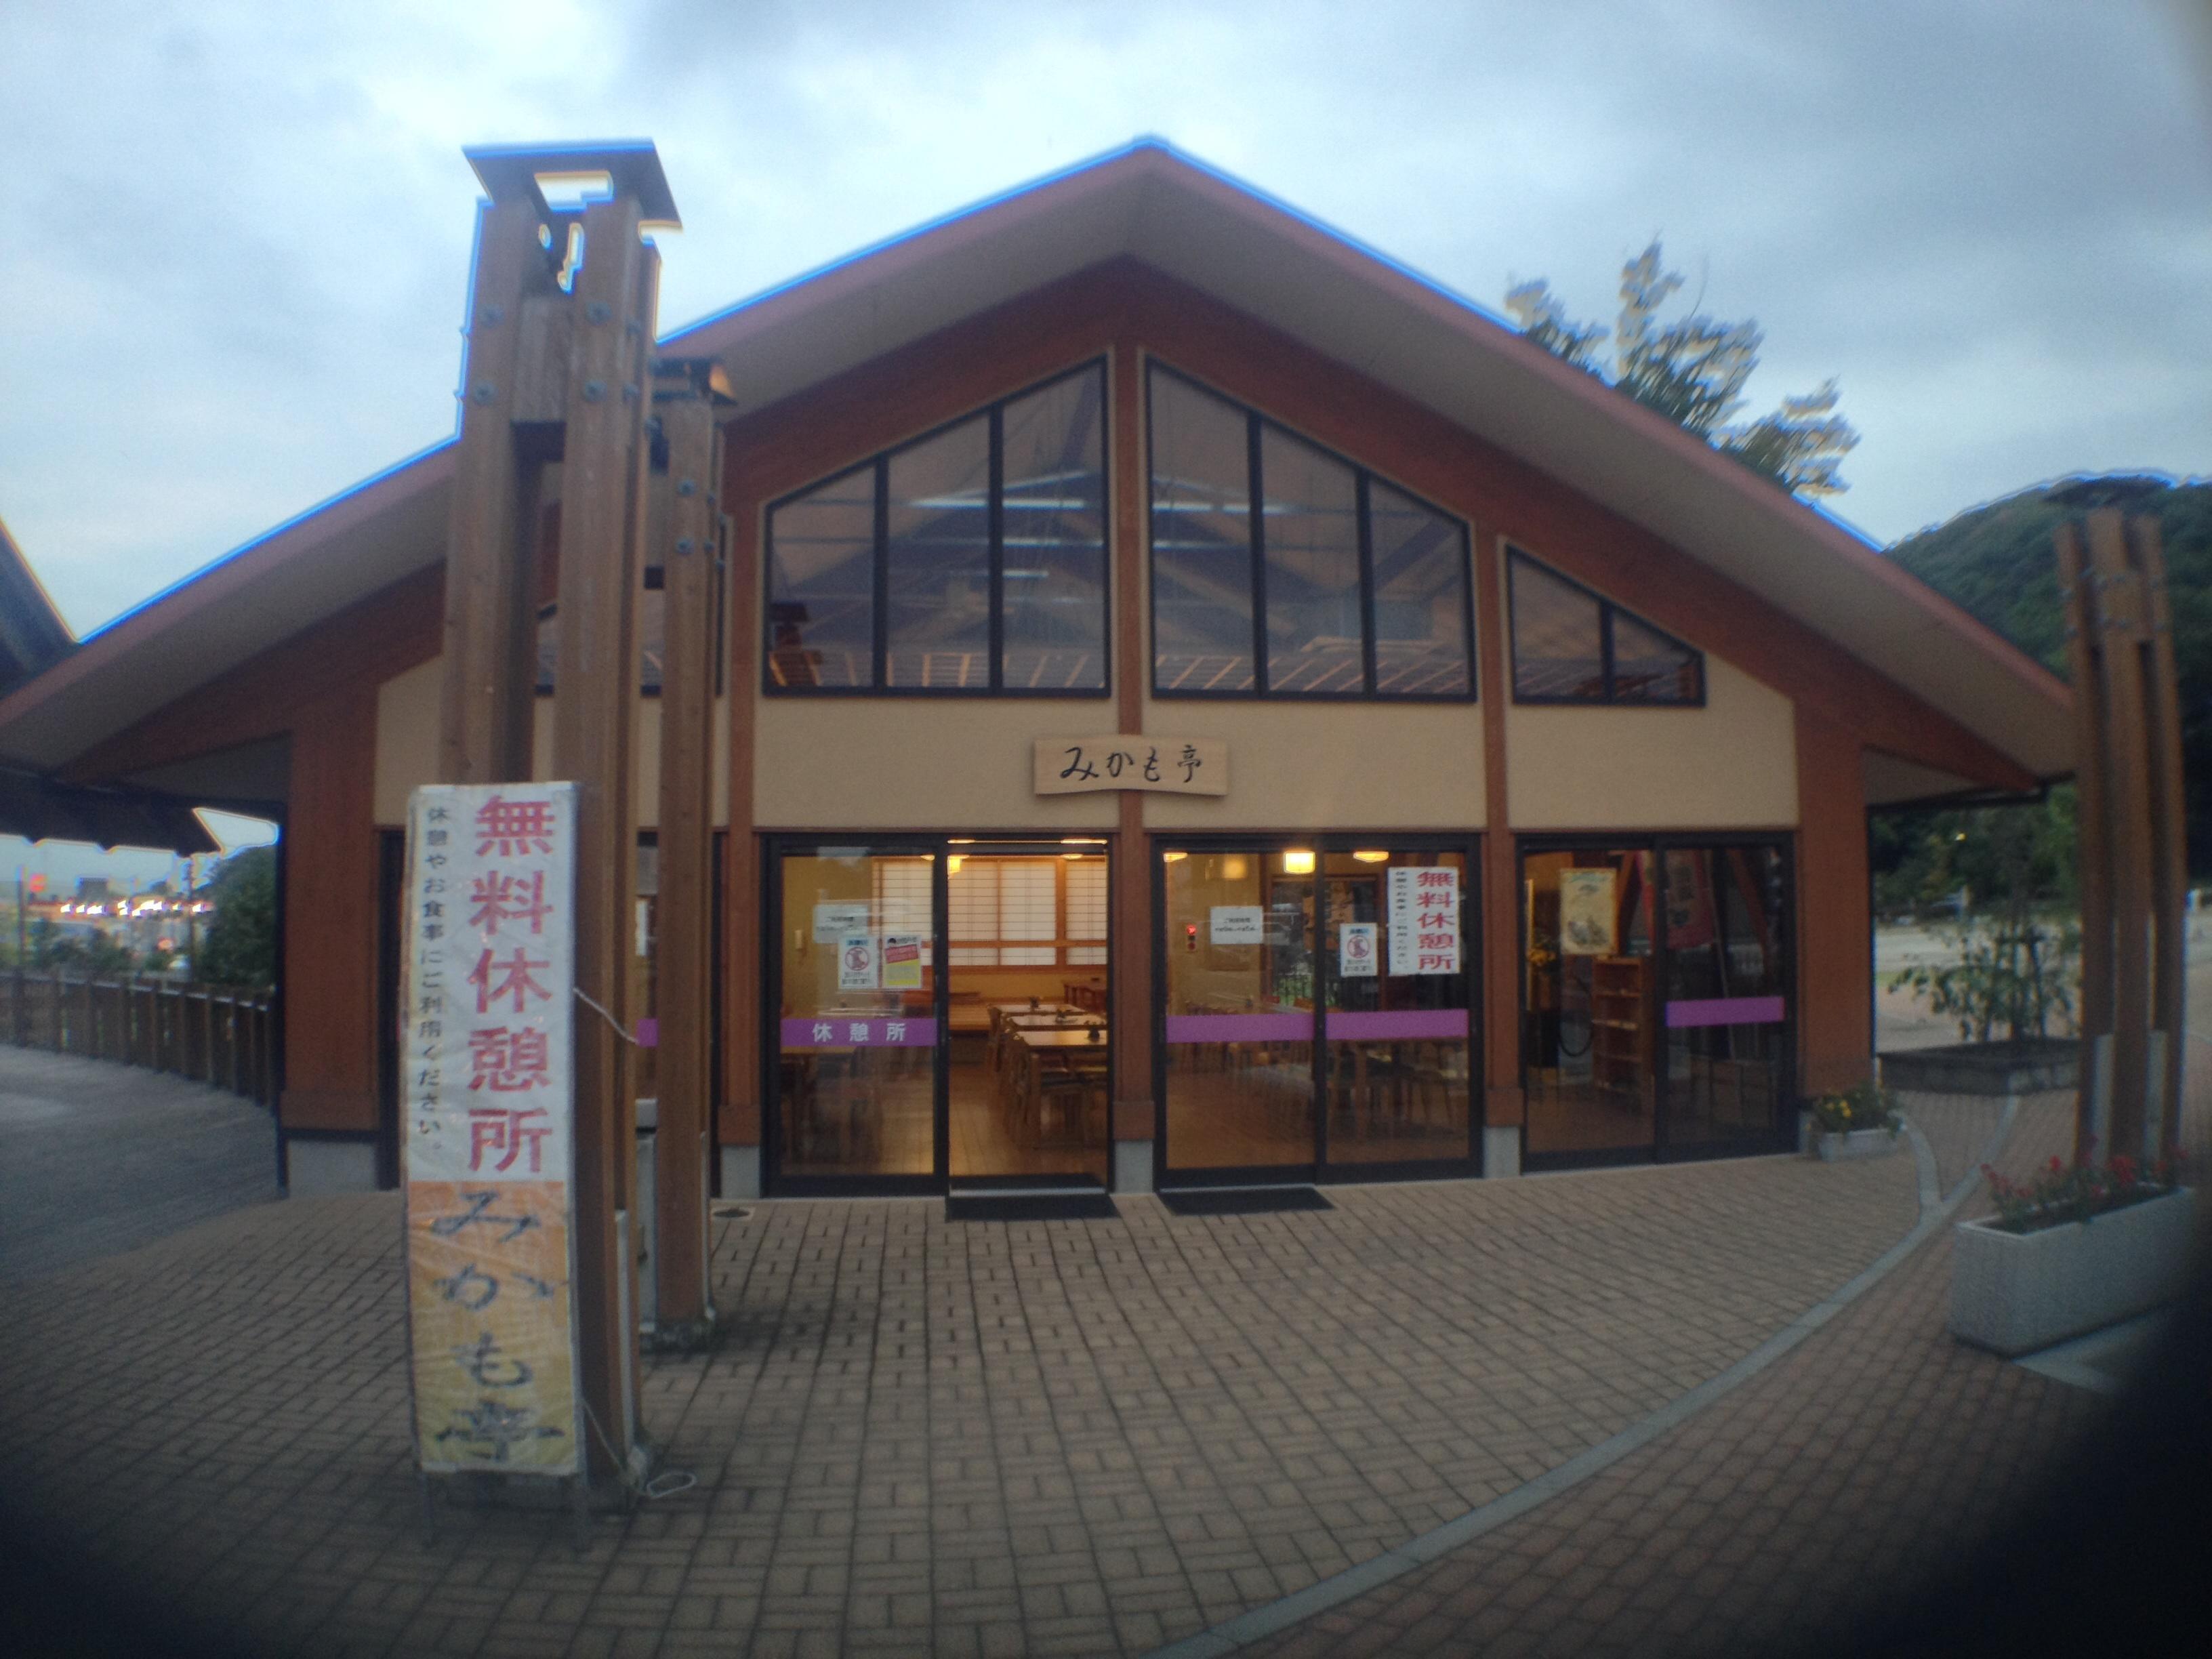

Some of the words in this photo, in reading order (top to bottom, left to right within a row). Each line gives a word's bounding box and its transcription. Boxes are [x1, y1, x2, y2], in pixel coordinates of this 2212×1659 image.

[1060, 744, 1203, 783] みかも亭
[1416, 872, 1456, 970] 無料休憩所
[468, 794, 556, 1174] 無料休憩所
[813, 1022, 907, 1043] 休憩所
